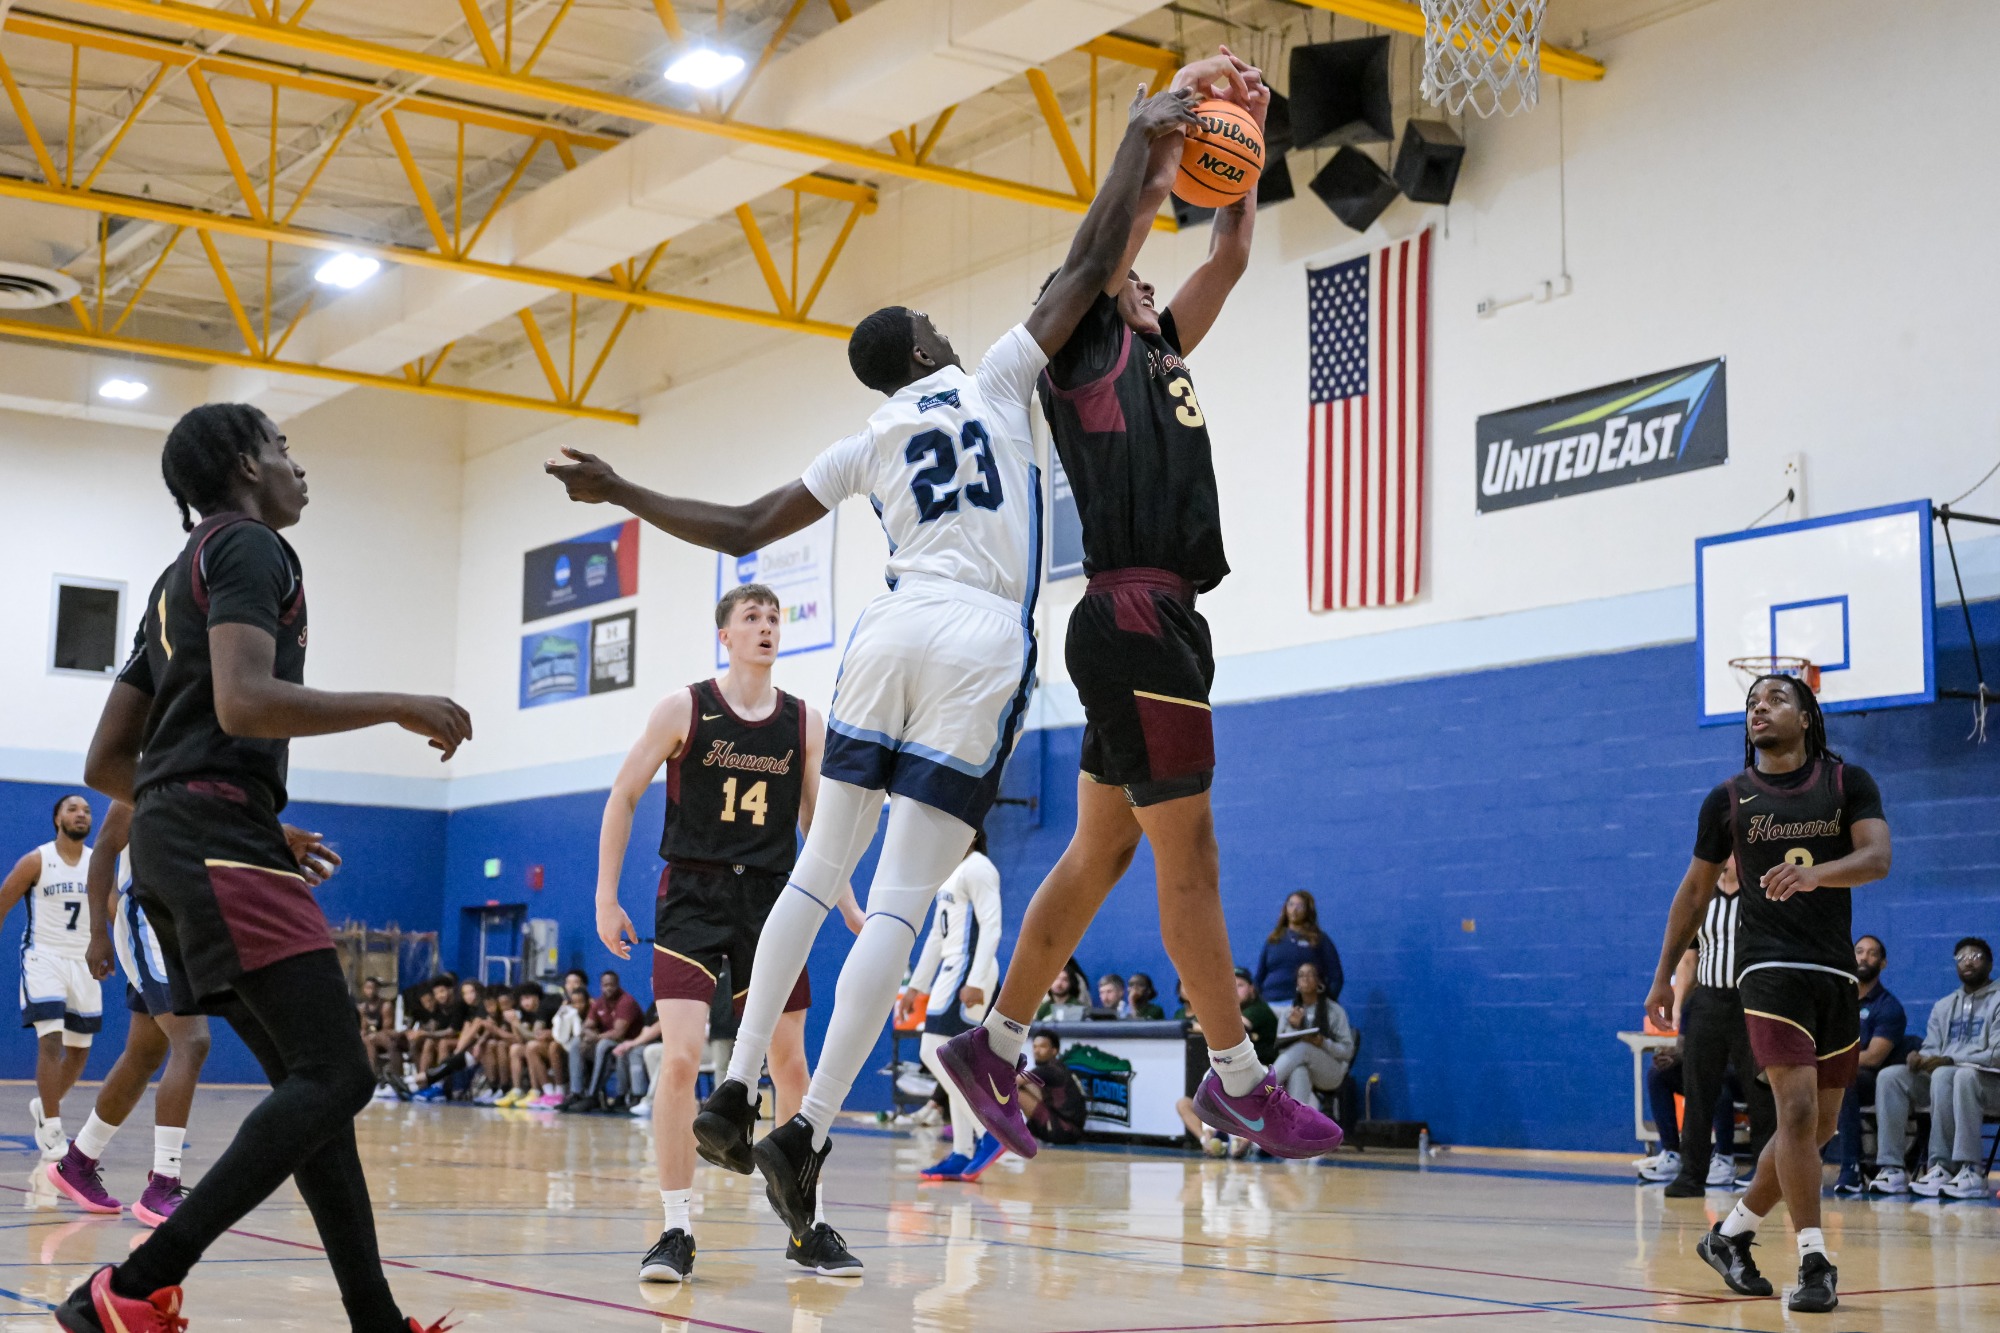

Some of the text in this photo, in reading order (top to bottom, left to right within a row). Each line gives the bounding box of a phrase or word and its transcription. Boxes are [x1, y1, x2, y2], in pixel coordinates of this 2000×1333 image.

[1200, 116, 1261, 159] Wilson
[1196, 151, 1246, 184] NCAA
[1168, 376, 1205, 428] 3
[904, 418, 1004, 524] 23
[703, 739, 794, 775] Howard
[720, 776, 768, 826] 14
[1746, 808, 1842, 844] Howard
[43, 882, 74, 897] NOTRE
[64, 901, 82, 931] 7
[940, 908, 949, 939] 0
